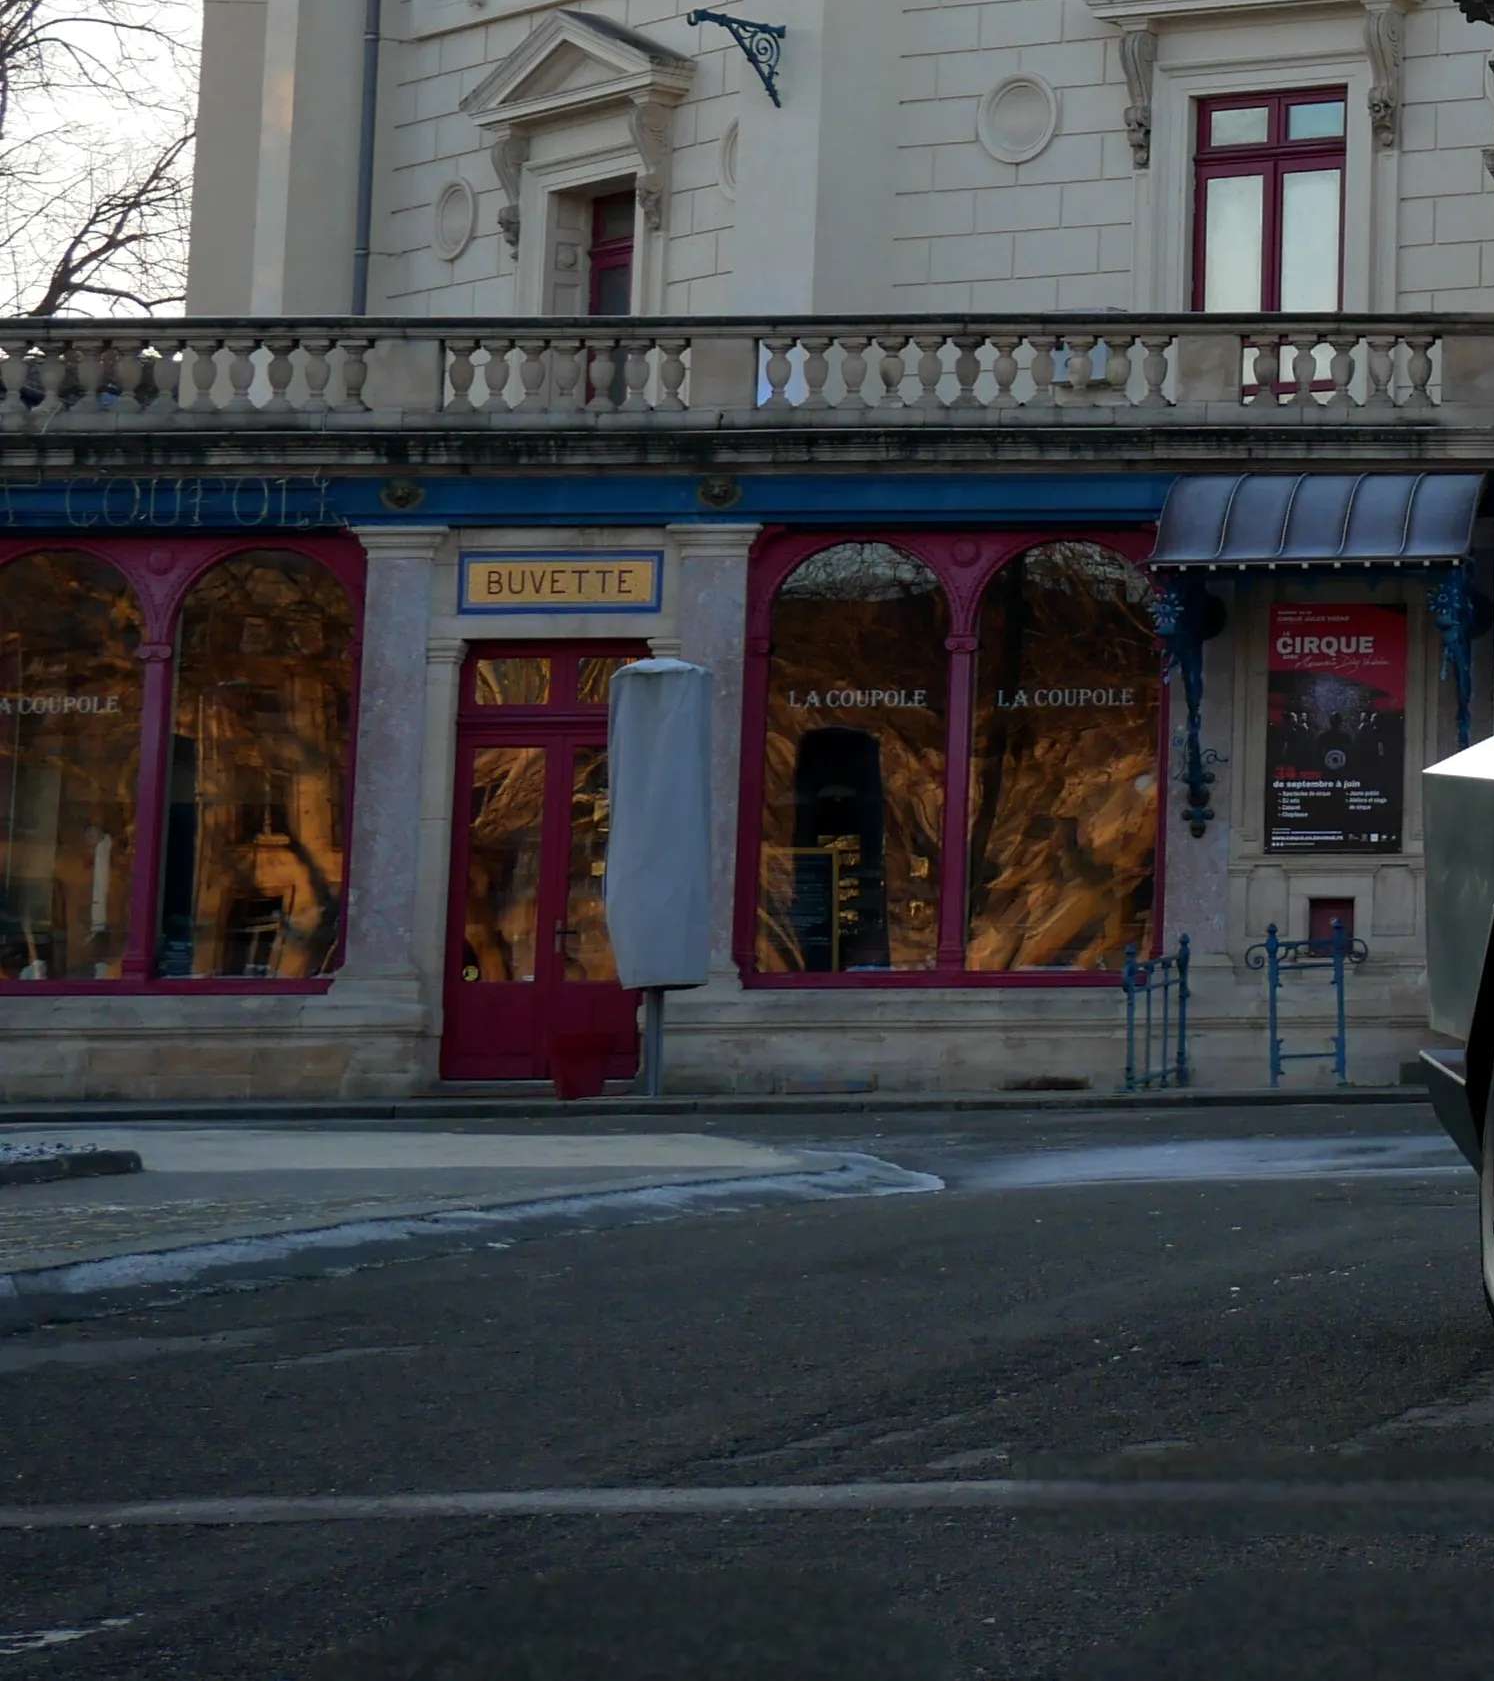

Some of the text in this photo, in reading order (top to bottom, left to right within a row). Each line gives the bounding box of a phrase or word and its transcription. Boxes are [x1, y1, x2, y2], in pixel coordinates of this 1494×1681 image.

[487, 569, 633, 595] BUVETTE
[1276, 635, 1375, 657] CIRQUE
[0, 695, 121, 715] A COUPOLE
[789, 689, 928, 709] LA COUPOLE
[997, 688, 1135, 709] LA COUPOLE
[1273, 780, 1285, 788] de
[1286, 780, 1334, 790] septembre
[1343, 780, 1361, 789] juin
